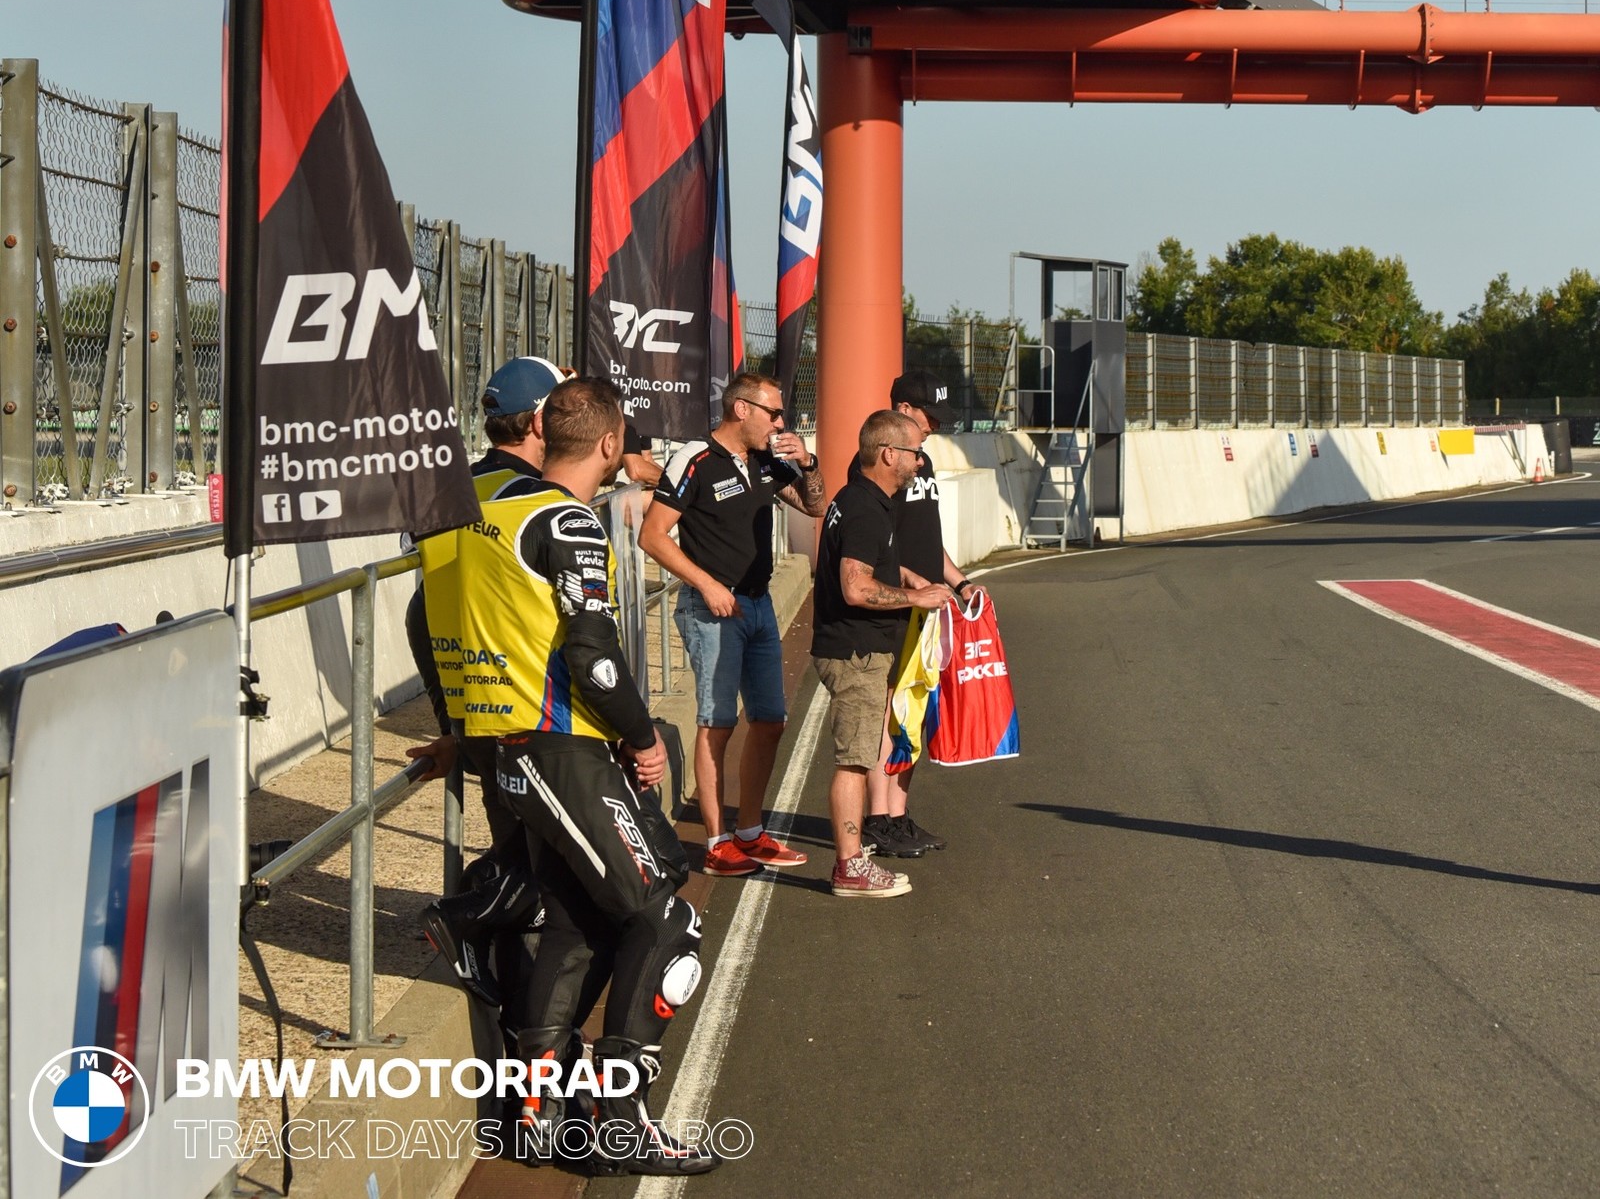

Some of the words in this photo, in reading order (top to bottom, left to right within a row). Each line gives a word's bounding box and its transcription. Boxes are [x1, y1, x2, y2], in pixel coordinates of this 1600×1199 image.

[261, 443, 452, 482] #bmcmoto
[576, 556, 604, 567] Kevlar
[602, 796, 660, 877] RST
